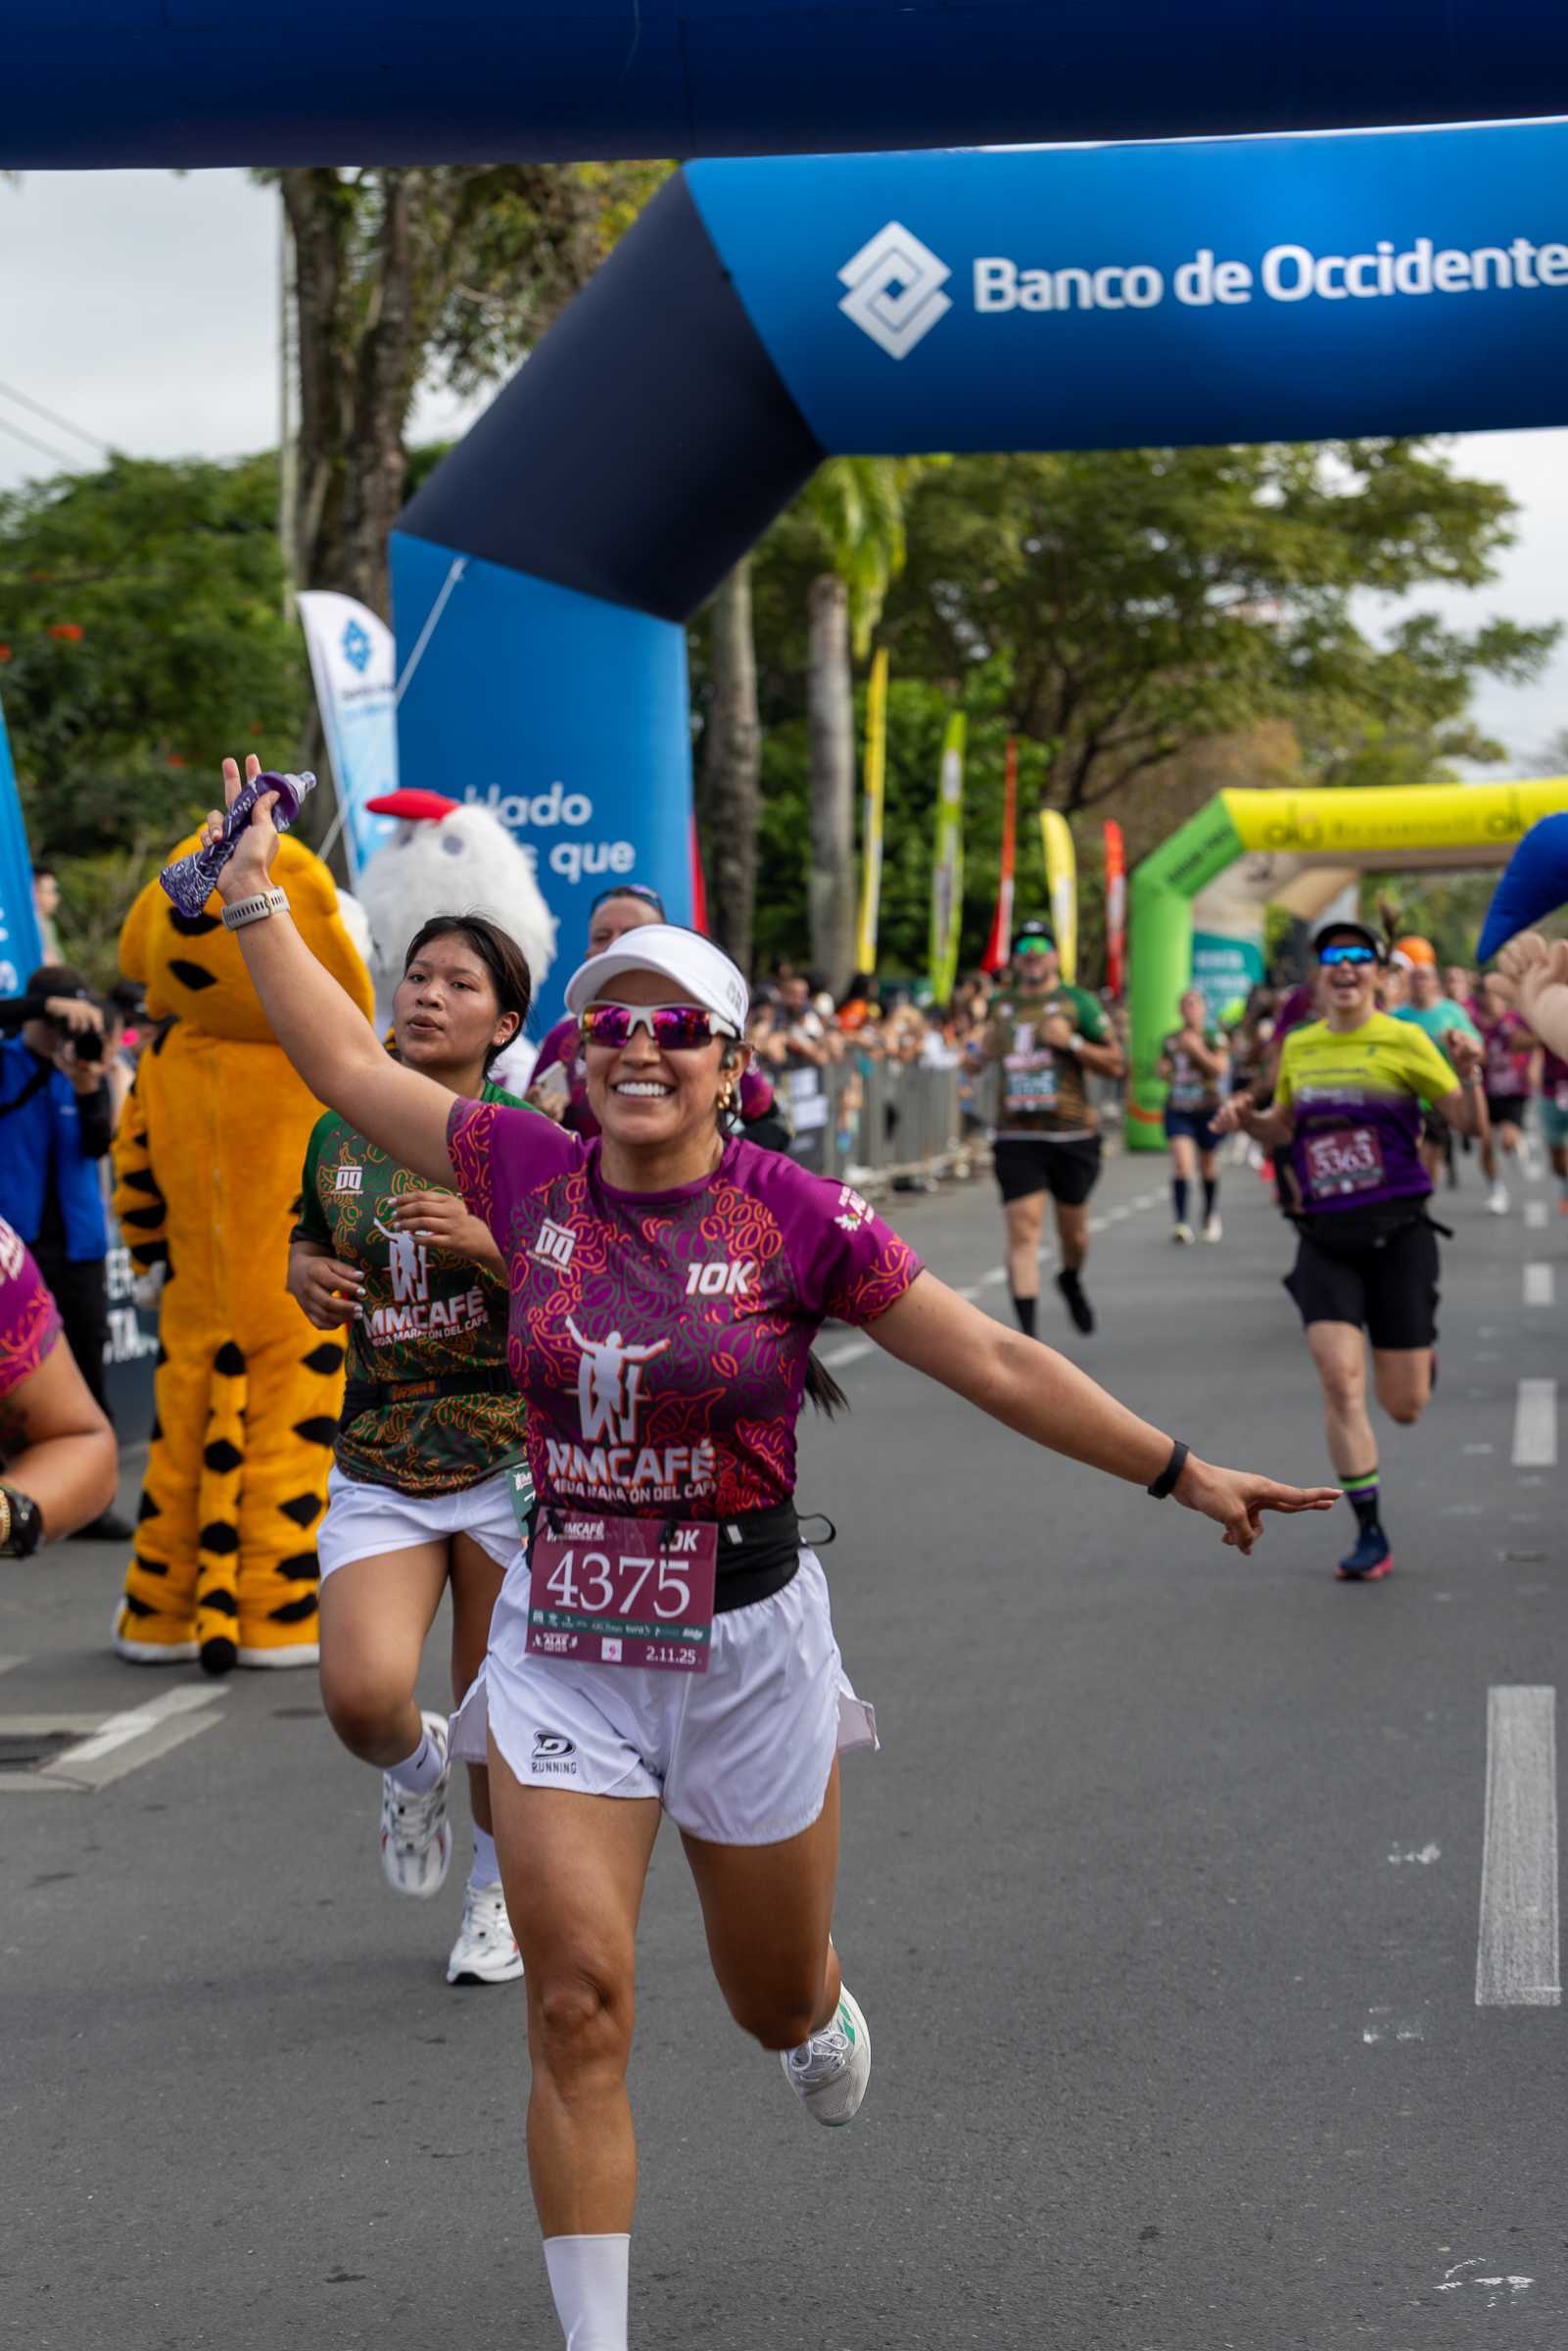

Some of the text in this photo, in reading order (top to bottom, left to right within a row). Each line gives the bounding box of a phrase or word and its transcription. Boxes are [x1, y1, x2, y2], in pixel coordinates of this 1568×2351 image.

[973, 238, 1568, 312] Banco de Occidente
[548, 840, 637, 885] que
[686, 1260, 755, 1295] 10K
[444, 1324, 463, 1337] DEL
[653, 1486, 681, 1501] DEL
[659, 1529, 700, 1553] 0K
[546, 1550, 690, 1618] 4375
[646, 1645, 696, 1665] 2.11.25
[532, 1760, 577, 1774] RUNNING
